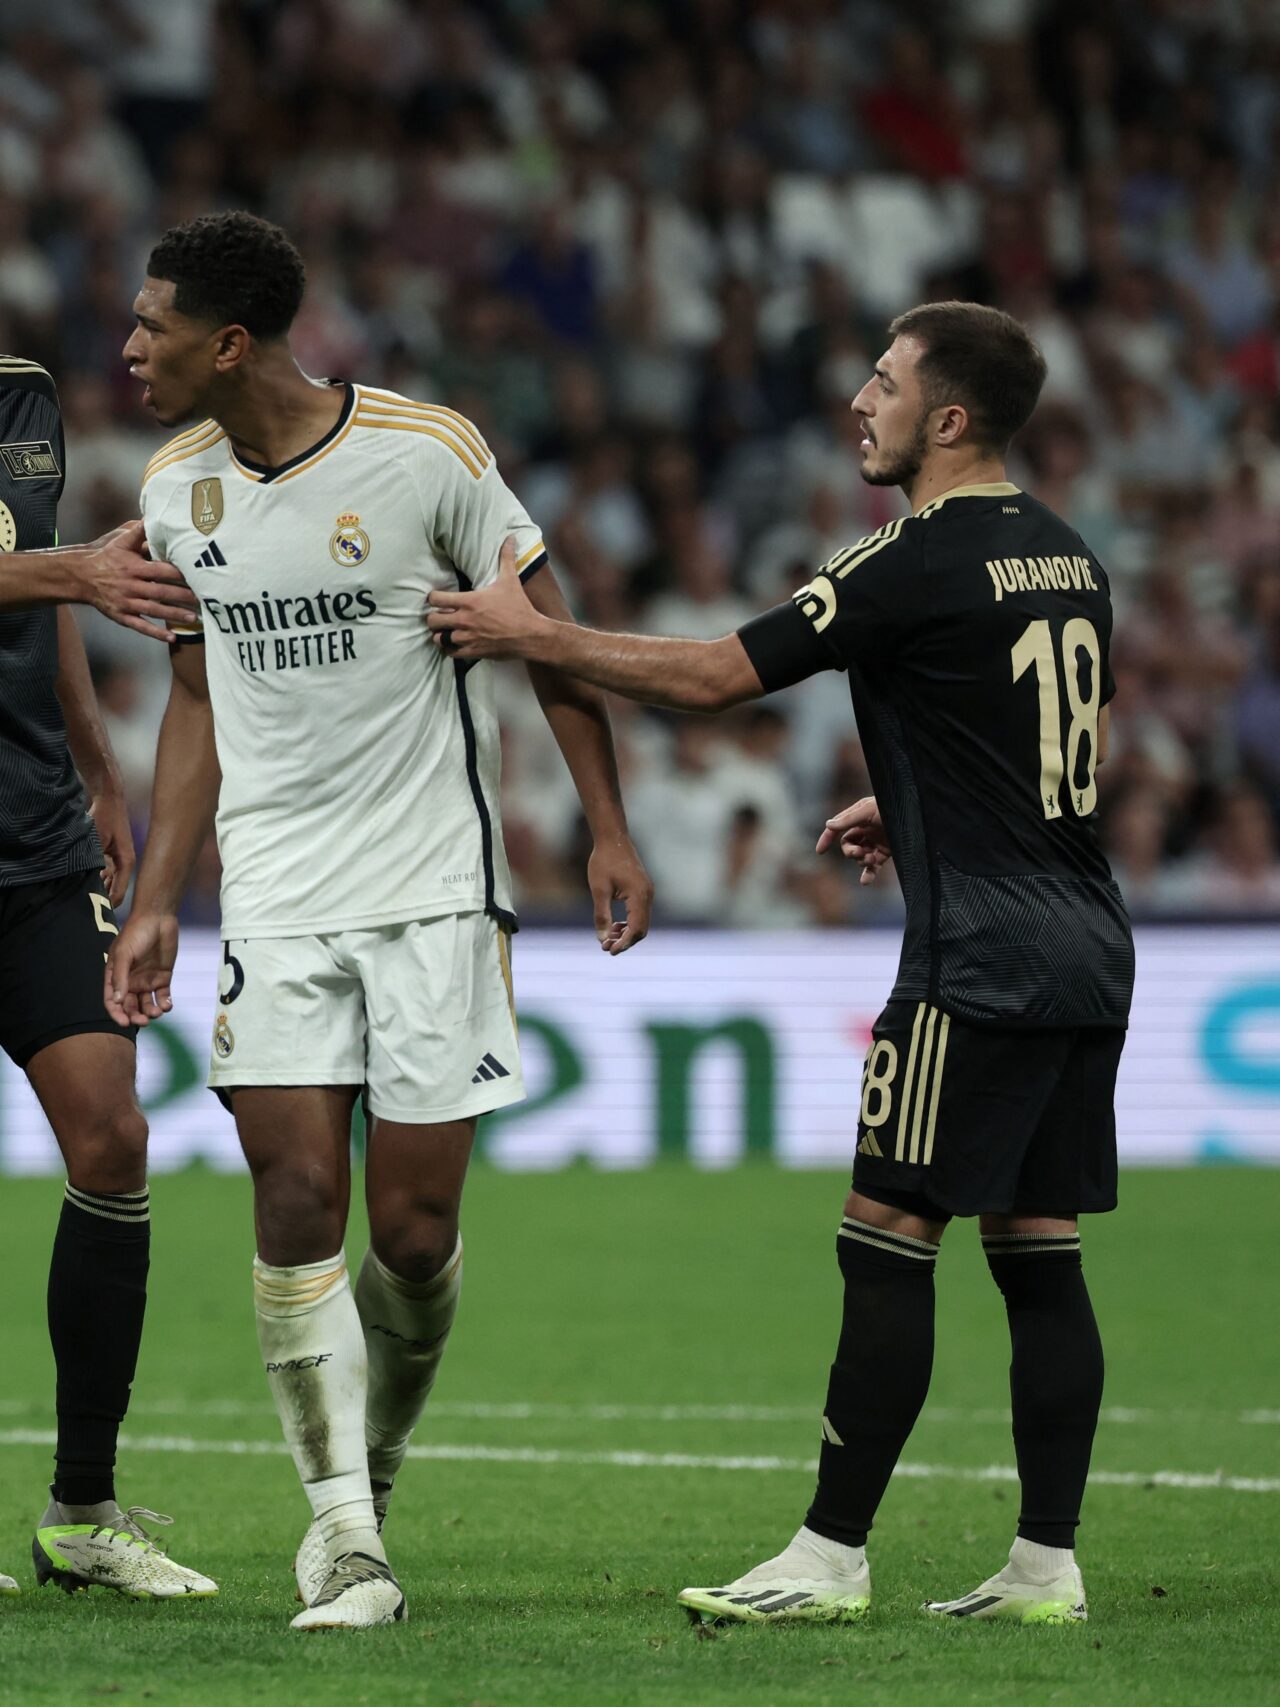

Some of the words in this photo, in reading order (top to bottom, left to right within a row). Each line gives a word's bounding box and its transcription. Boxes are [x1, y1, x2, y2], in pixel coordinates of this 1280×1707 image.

[200, 513, 216, 523] FIFA
[203, 589, 377, 634] Emirates
[237, 640, 265, 672] FLY
[274, 628, 357, 671] BETTER
[1011, 617, 1101, 820] 18
[857, 1039, 898, 1127] 8
[266, 1353, 333, 1374] RMCF
[86, 1543, 115, 1553] PREDATOR
